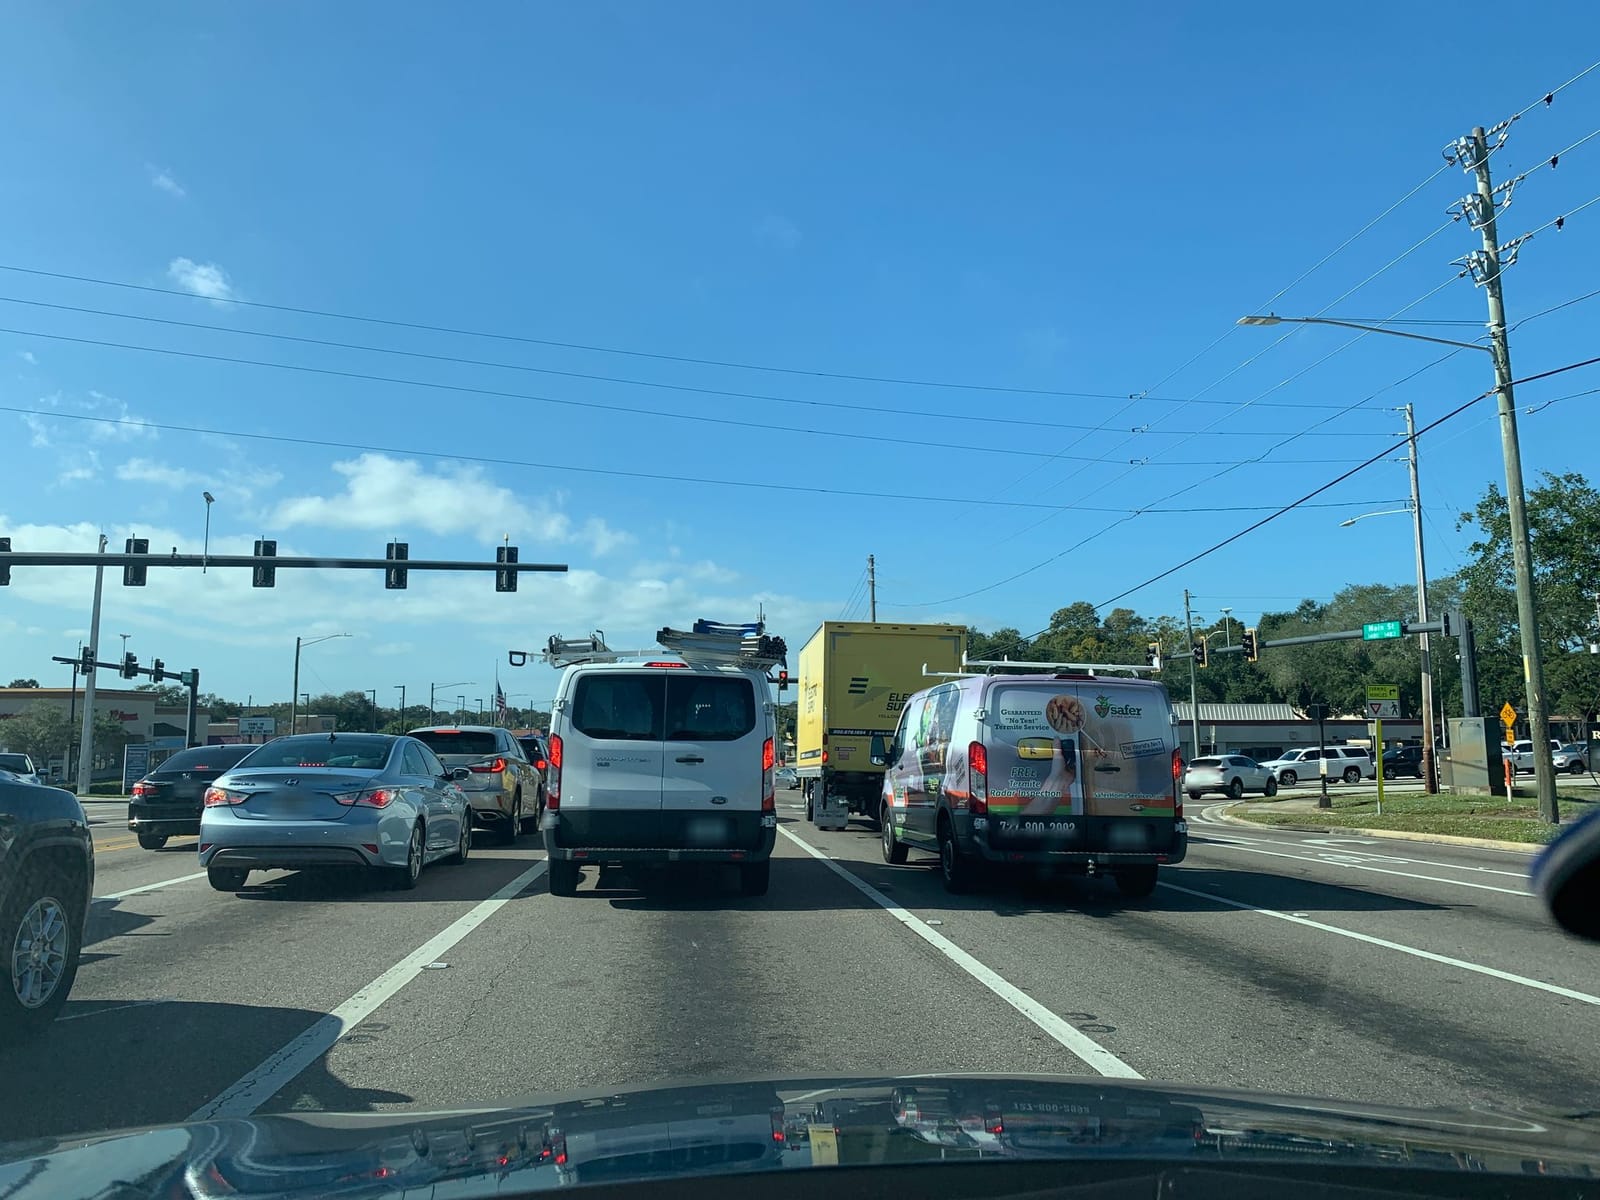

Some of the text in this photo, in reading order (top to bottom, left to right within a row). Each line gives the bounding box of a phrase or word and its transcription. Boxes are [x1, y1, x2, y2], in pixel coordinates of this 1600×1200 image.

[1368, 622, 1395, 632] Main St
[1110, 704, 1142, 716] safer
[1010, 766, 1038, 778] FREE
[1008, 779, 1042, 789] Termite
[990, 788, 1063, 798] Radar Inspection
